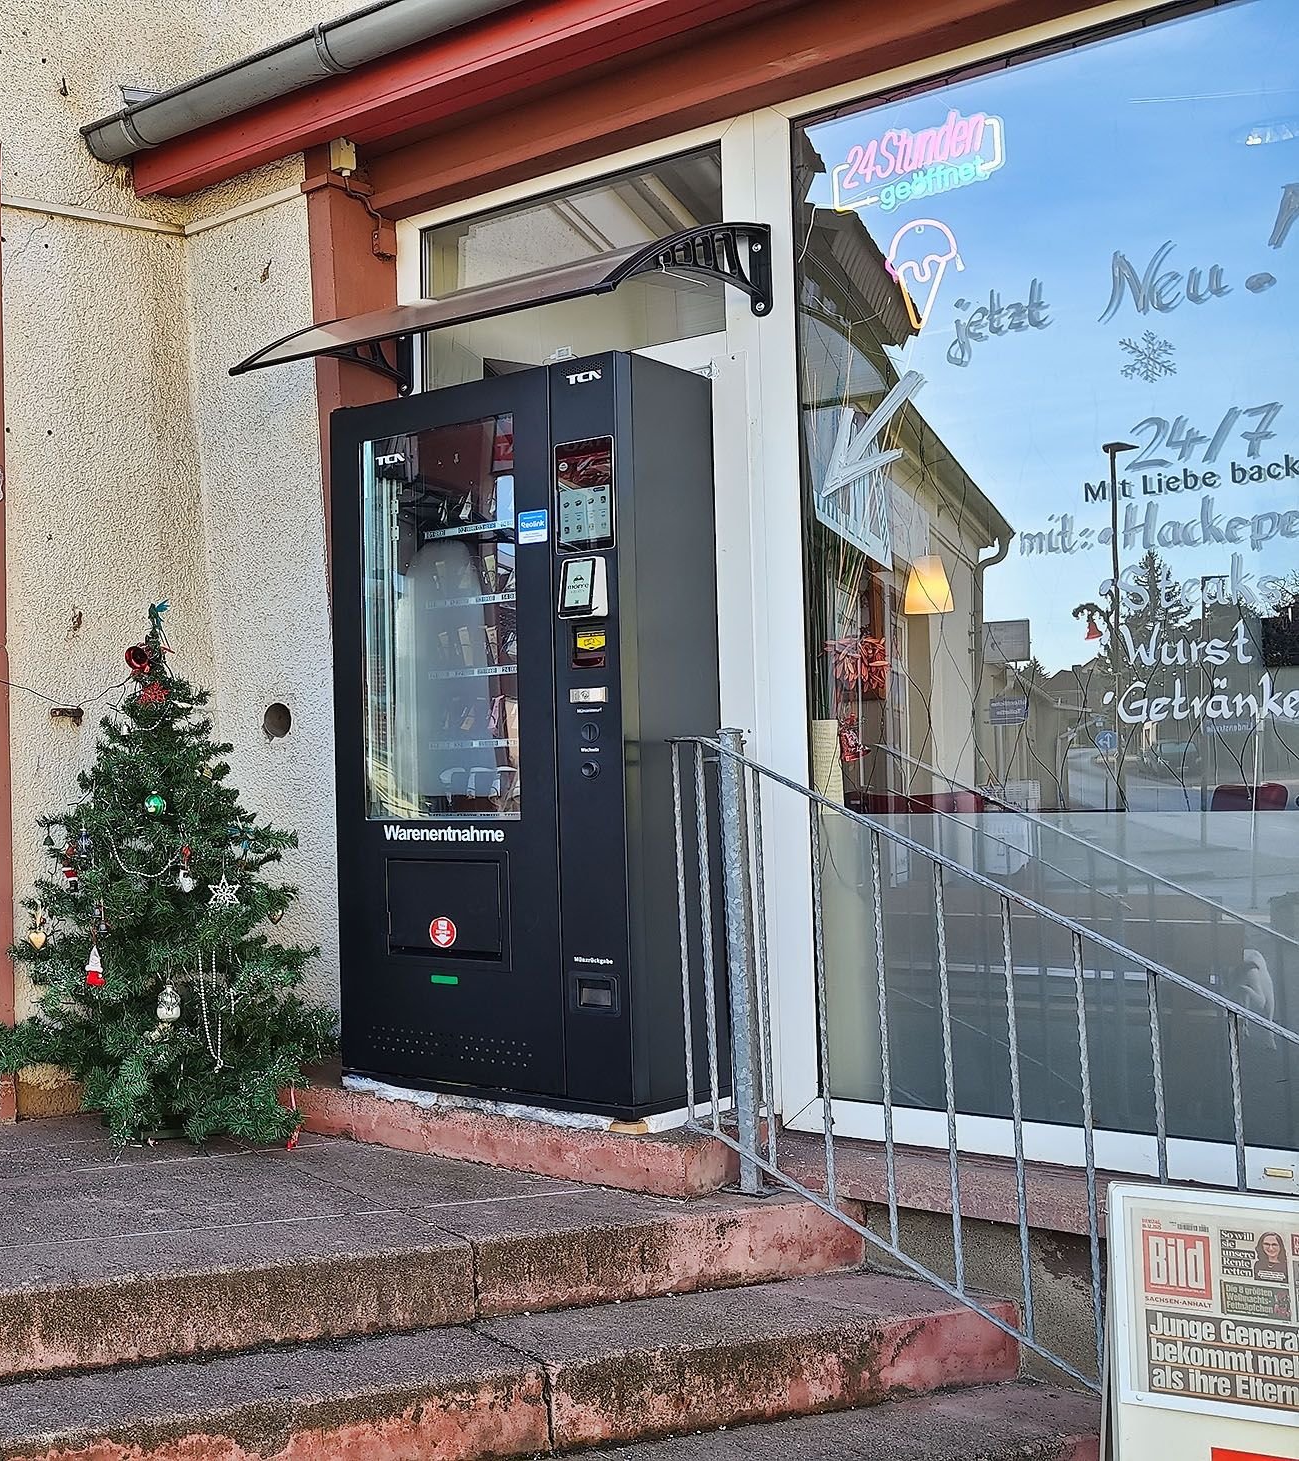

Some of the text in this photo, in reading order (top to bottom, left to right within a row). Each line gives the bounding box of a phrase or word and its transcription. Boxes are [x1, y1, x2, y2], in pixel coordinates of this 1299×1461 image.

[879, 155, 986, 210] geöffnet
[947, 278, 1054, 367] jetzt
[566, 370, 602, 385] TCN
[1125, 401, 1284, 472] 24/7
[375, 453, 406, 466] TCN
[1084, 479, 1134, 504] Mt
[1142, 468, 1220, 496] Liebe
[1117, 552, 1287, 611] Steaks
[1119, 619, 1253, 666] Wurst
[1117, 672, 1299, 723] Getränke
[383, 824, 505, 843] Warenentnahme
[1221, 1230, 1253, 1241] So will
[1221, 1240, 1235, 1248] sie
[1148, 1235, 1206, 1290] Bild
[1222, 1250, 1254, 1259] unsere
[1222, 1257, 1251, 1268] Rente
[1223, 1268, 1252, 1277] retten
[1145, 1295, 1213, 1309] SACHSEN-ANHALT
[1150, 1312, 1216, 1343] Junge
[1150, 1338, 1254, 1373] bekommt
[1152, 1365, 1299, 1406] als ihre Eltern
